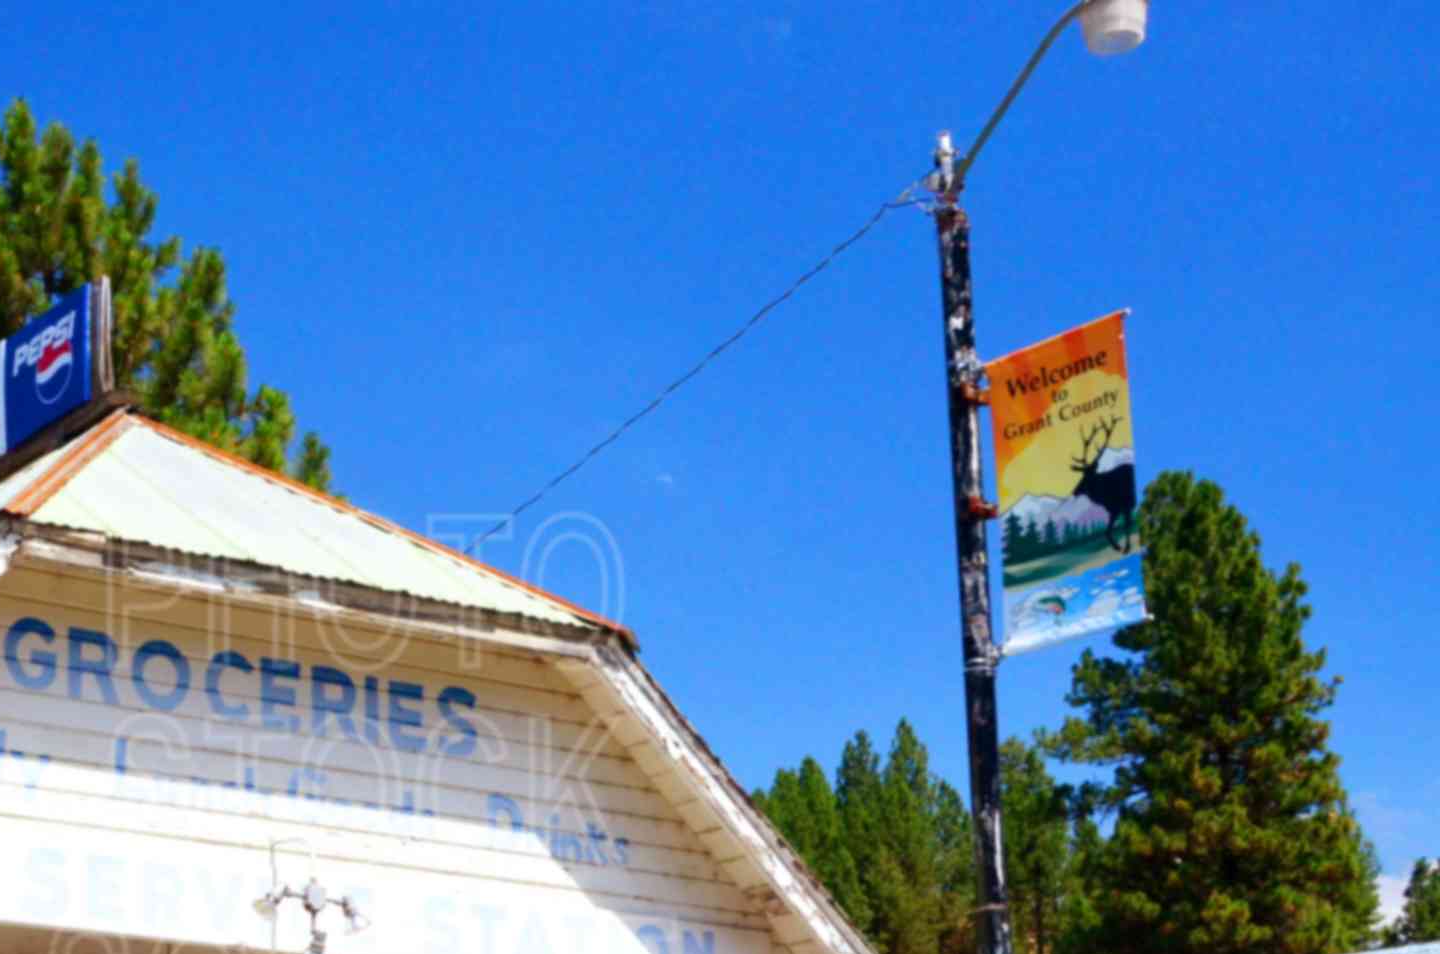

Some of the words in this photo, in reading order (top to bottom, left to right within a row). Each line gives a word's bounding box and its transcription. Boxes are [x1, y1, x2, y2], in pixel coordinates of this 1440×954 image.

[13, 310, 76, 377] PEPSI
[1005, 349, 1108, 400] Welcome
[1051, 387, 1069, 403] to
[1003, 411, 1053, 440] Grant
[1058, 388, 1120, 422] County
[3, 616, 478, 758] GROCERIES
